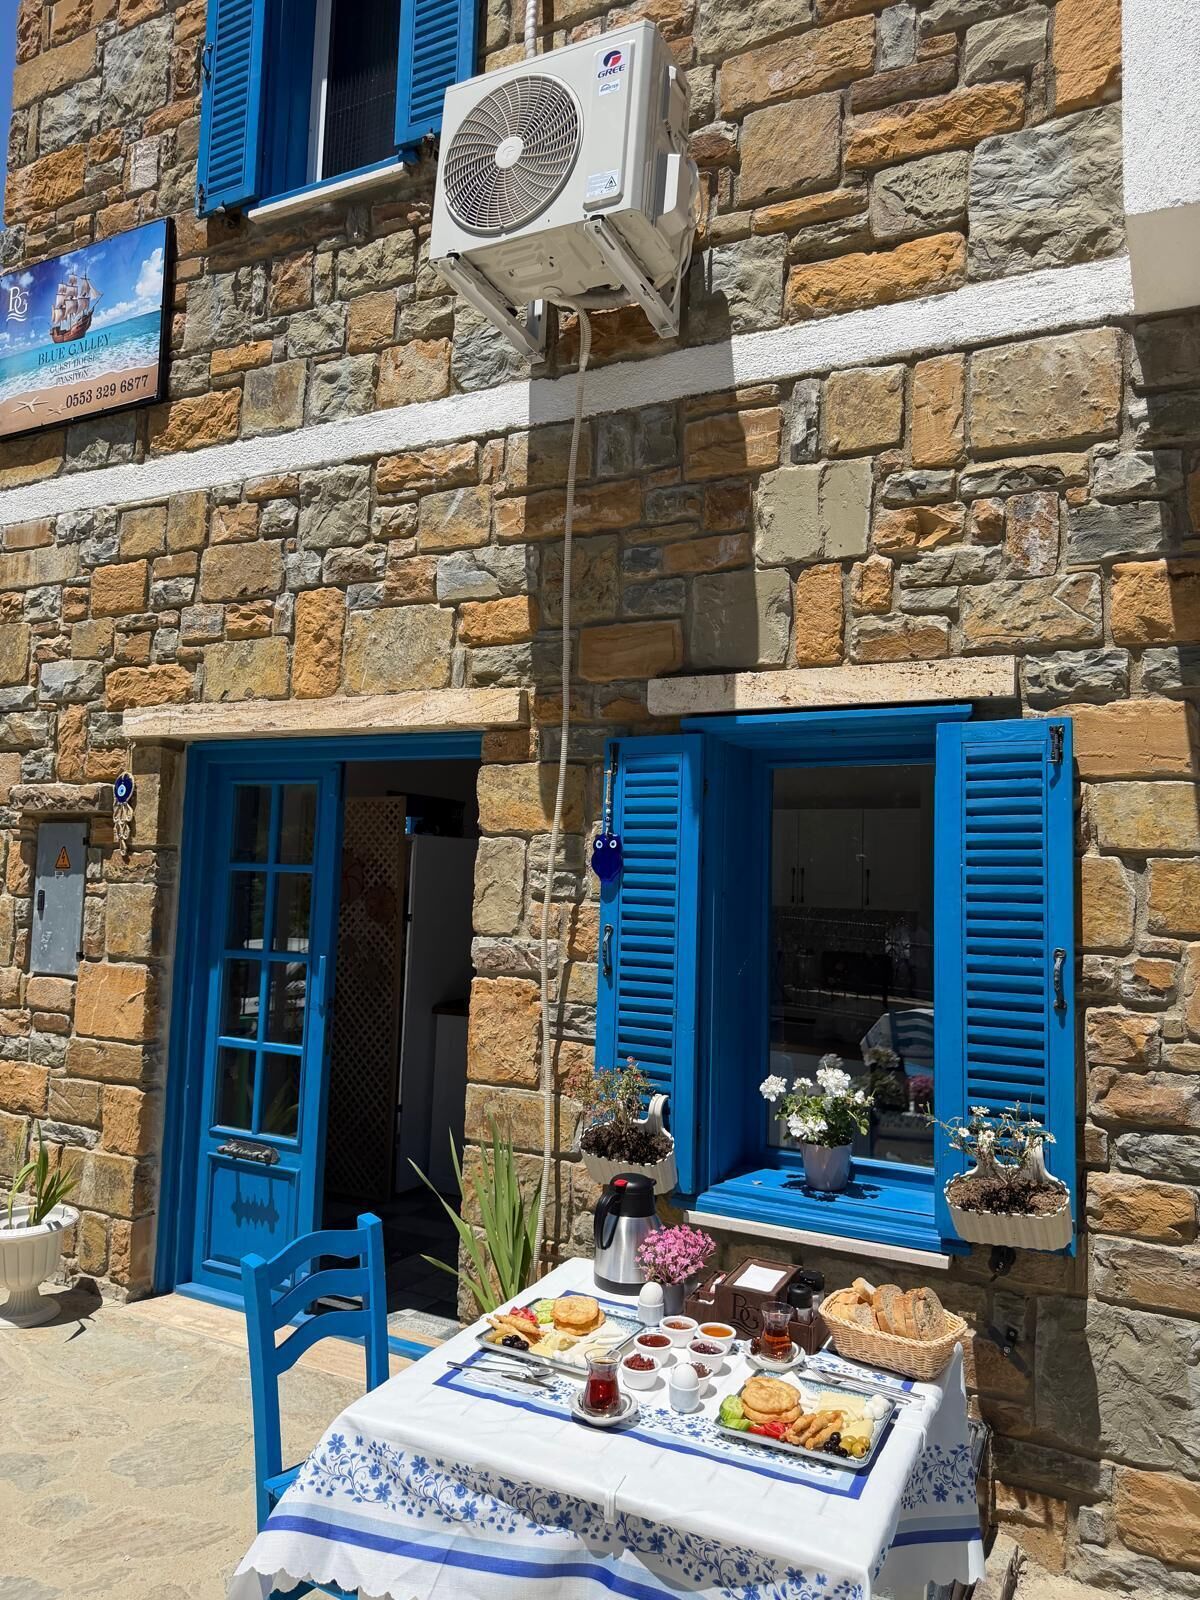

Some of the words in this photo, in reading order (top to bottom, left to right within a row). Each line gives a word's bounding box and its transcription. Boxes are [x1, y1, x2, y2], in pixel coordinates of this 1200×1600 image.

[598, 64, 625, 78] GREE
[38, 346, 65, 365] BLUE
[68, 332, 111, 356] GALLEY
[66, 389, 93, 408] 0553
[96, 383, 117, 400] 329
[120, 374, 149, 393] 6877
